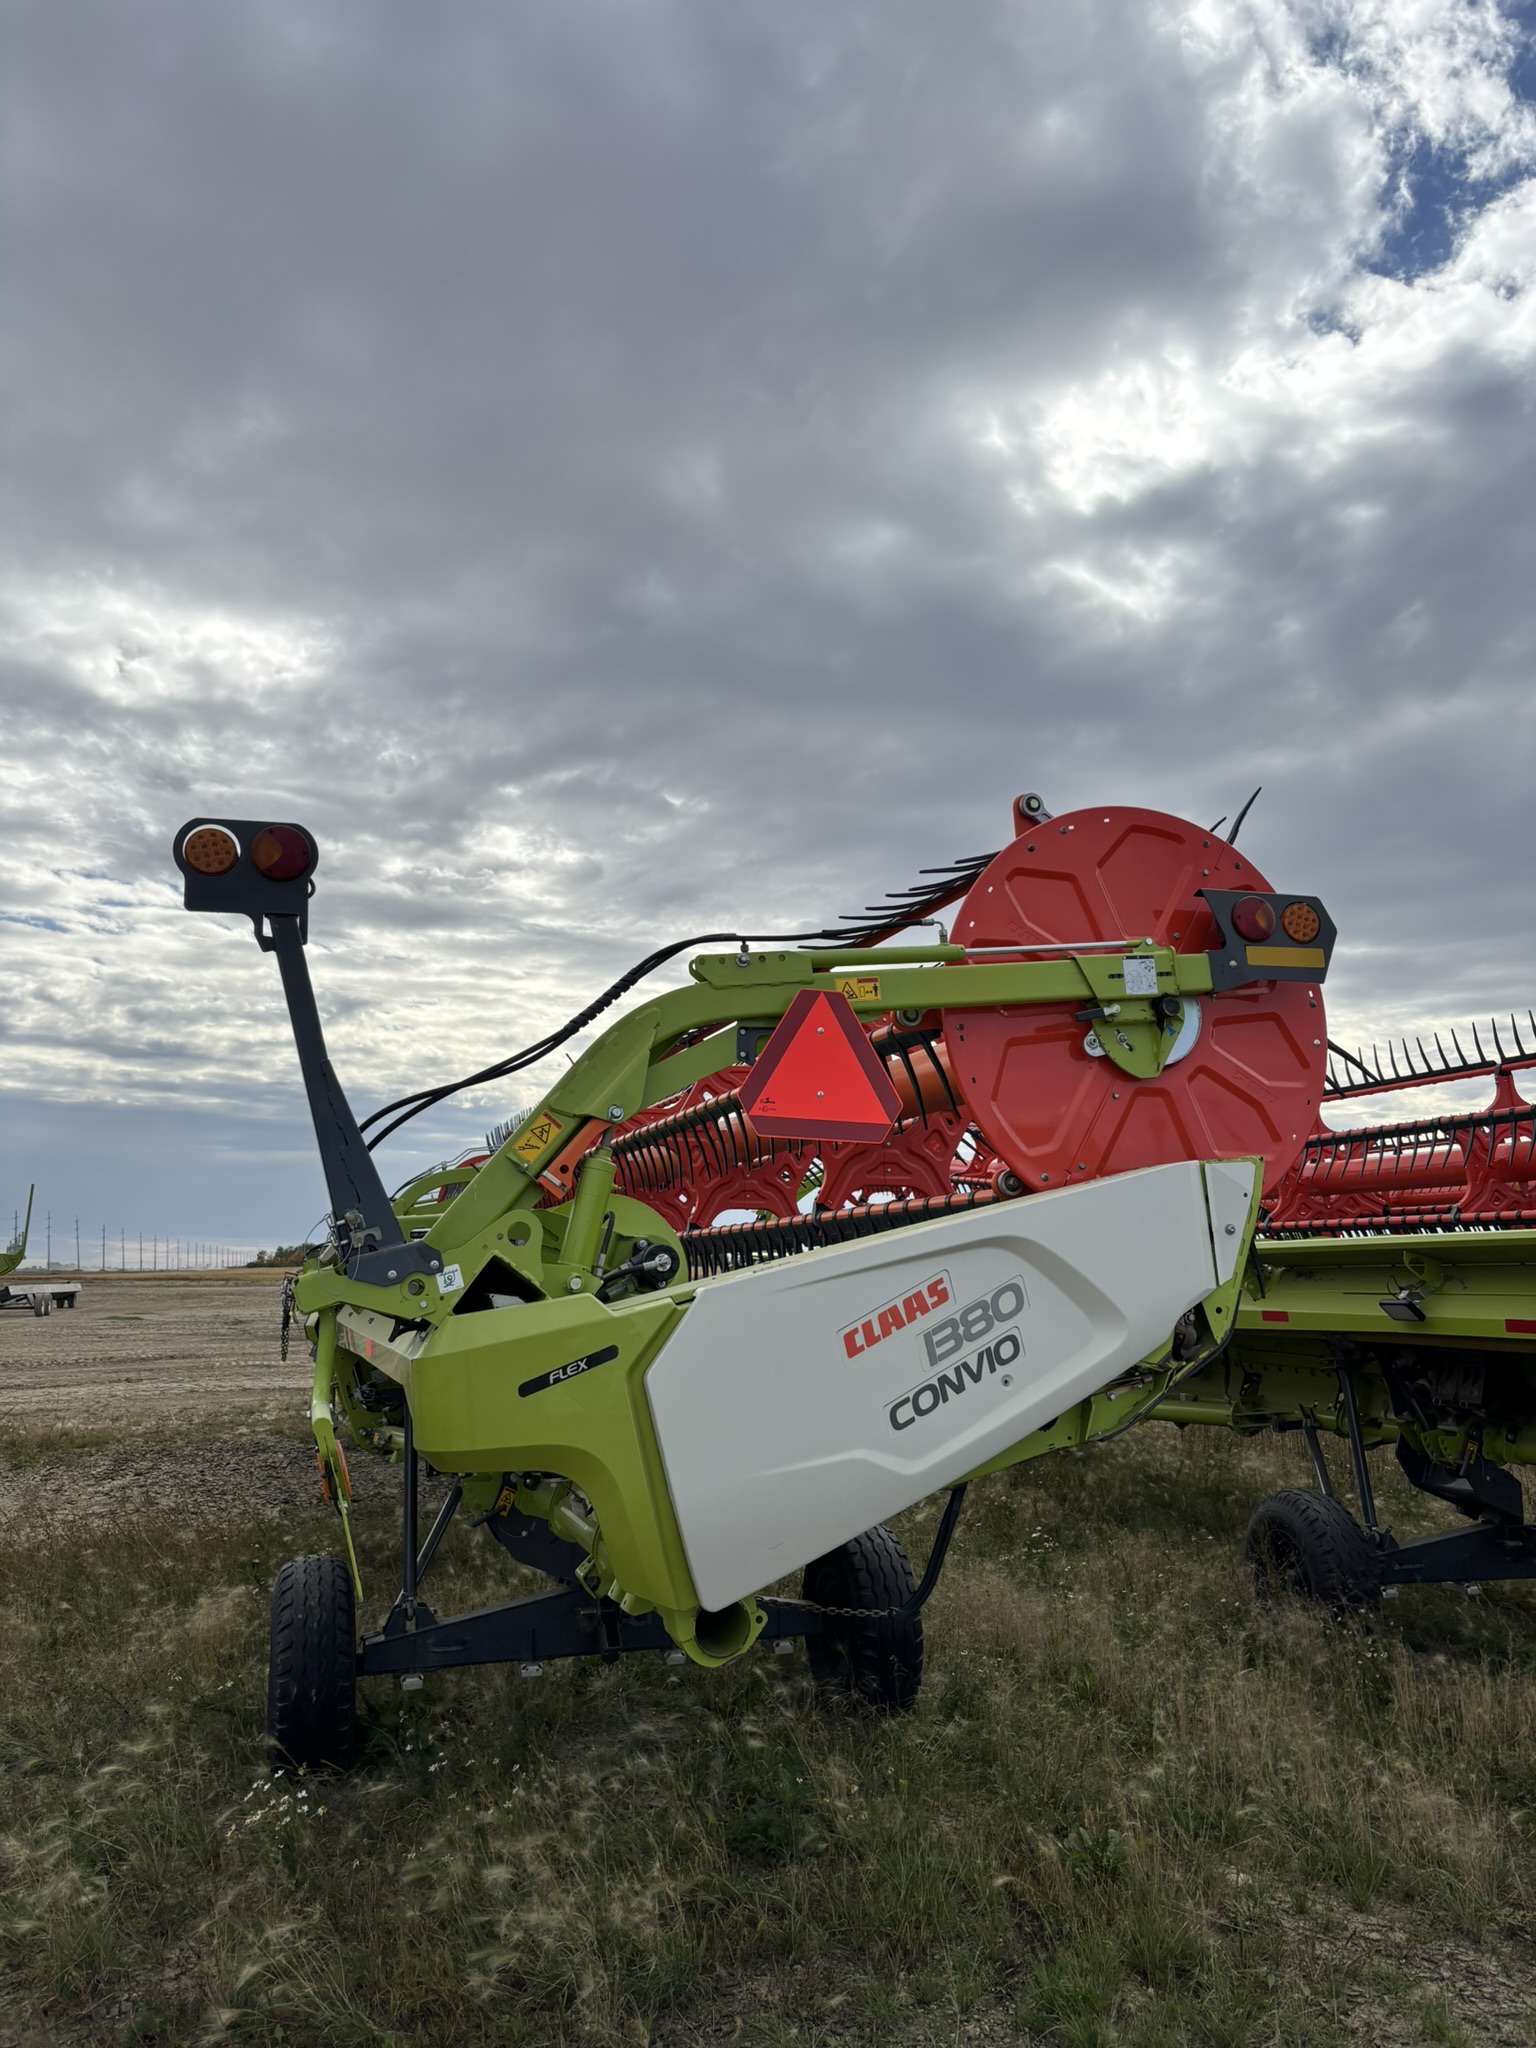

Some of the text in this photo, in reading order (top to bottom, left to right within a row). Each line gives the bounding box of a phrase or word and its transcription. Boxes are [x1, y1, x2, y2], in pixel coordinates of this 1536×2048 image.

[843, 1277, 950, 1359] CLAAS
[549, 1358, 588, 1384] FLEX
[889, 1334, 1021, 1431] CONVIO
